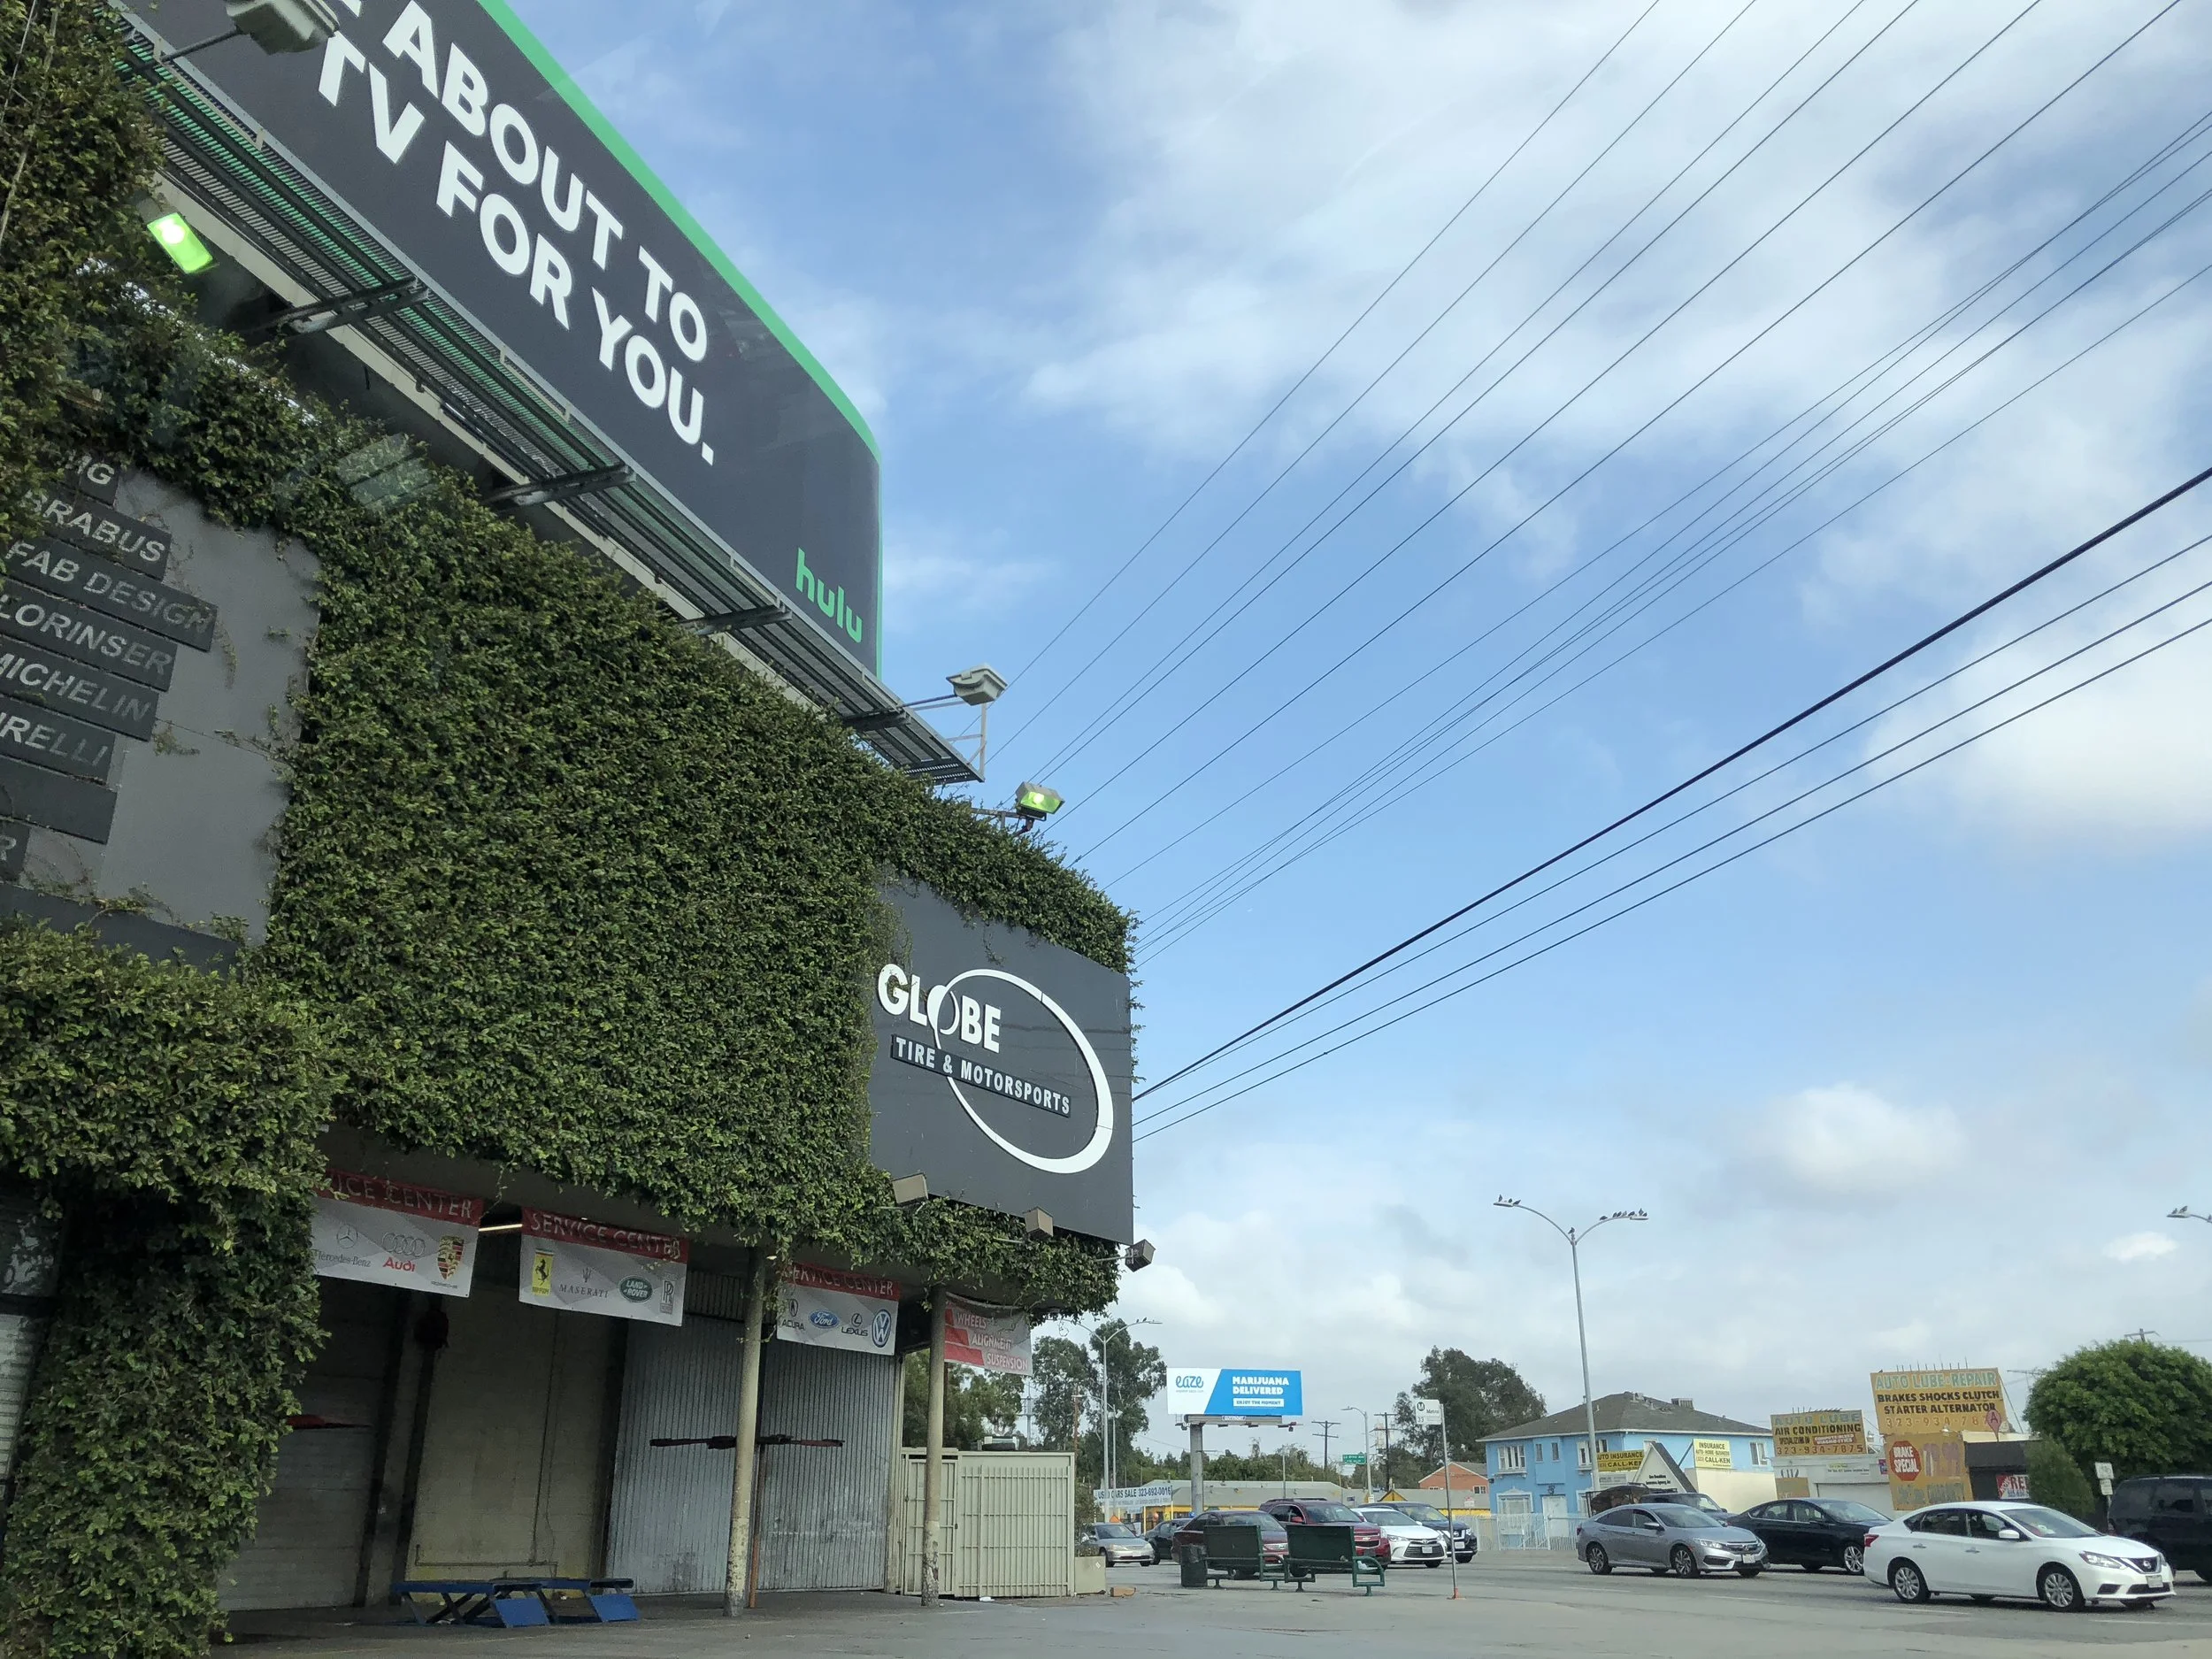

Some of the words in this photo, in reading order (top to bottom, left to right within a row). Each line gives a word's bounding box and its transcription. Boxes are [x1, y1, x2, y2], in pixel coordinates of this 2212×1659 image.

[382, 0, 623, 270] ABOUT
[637, 245, 709, 362] TO
[319, 30, 425, 165] TV
[436, 142, 573, 329] FOR
[591, 287, 714, 465] YOU.
[4, 540, 81, 582] FAB
[83, 572, 215, 634] DESIGN
[795, 547, 863, 643] hulu
[877, 963, 1002, 1054] GLOBE
[895, 1035, 935, 1070] TIRE
[942, 1054, 953, 1074] &
[960, 1059, 1071, 1116] MOTORSPORTS
[387, 1183, 472, 1218] CENTER
[531, 1213, 607, 1244] SERVICE
[382, 1256, 416, 1272] Audi
[792, 1264, 841, 1287] ERVICE
[843, 1274, 894, 1296] CENTER
[558, 1284, 609, 1299] MASERATI
[626, 1288, 648, 1297] ROVER
[781, 1318, 806, 1331] ACURA
[813, 1311, 834, 1325] Ford
[956, 1312, 987, 1329] WHEELS
[841, 1326, 869, 1337] LEXUS
[972, 1333, 1012, 1351] ALIGNMENT
[987, 1353, 1028, 1371] SUSPENSION
[1175, 1375, 1204, 1388] eaze
[1232, 1376, 1289, 1386] MARIJUANA
[1875, 1374, 1909, 1390] AUTO
[1232, 1386, 1284, 1395] DELIVERED
[1877, 1393, 1916, 1403] BRAKES
[1919, 1391, 1961, 1402] SHOCKS
[1962, 1390, 2000, 1400] CLUTCH
[1884, 1404, 1928, 1414] STARTER
[1930, 1402, 1997, 1414] ALTERNATOR
[1990, 1411, 1999, 1424] A
[1775, 1426, 1790, 1436] AIR
[1792, 1424, 1862, 1435] CONDITIONING
[1699, 1441, 1725, 1450] INSURANCE
[1893, 1446, 1915, 1458] BRAKE
[1893, 1458, 1919, 1473] SPECIAL
[1125, 1488, 1137, 1497] SALE
